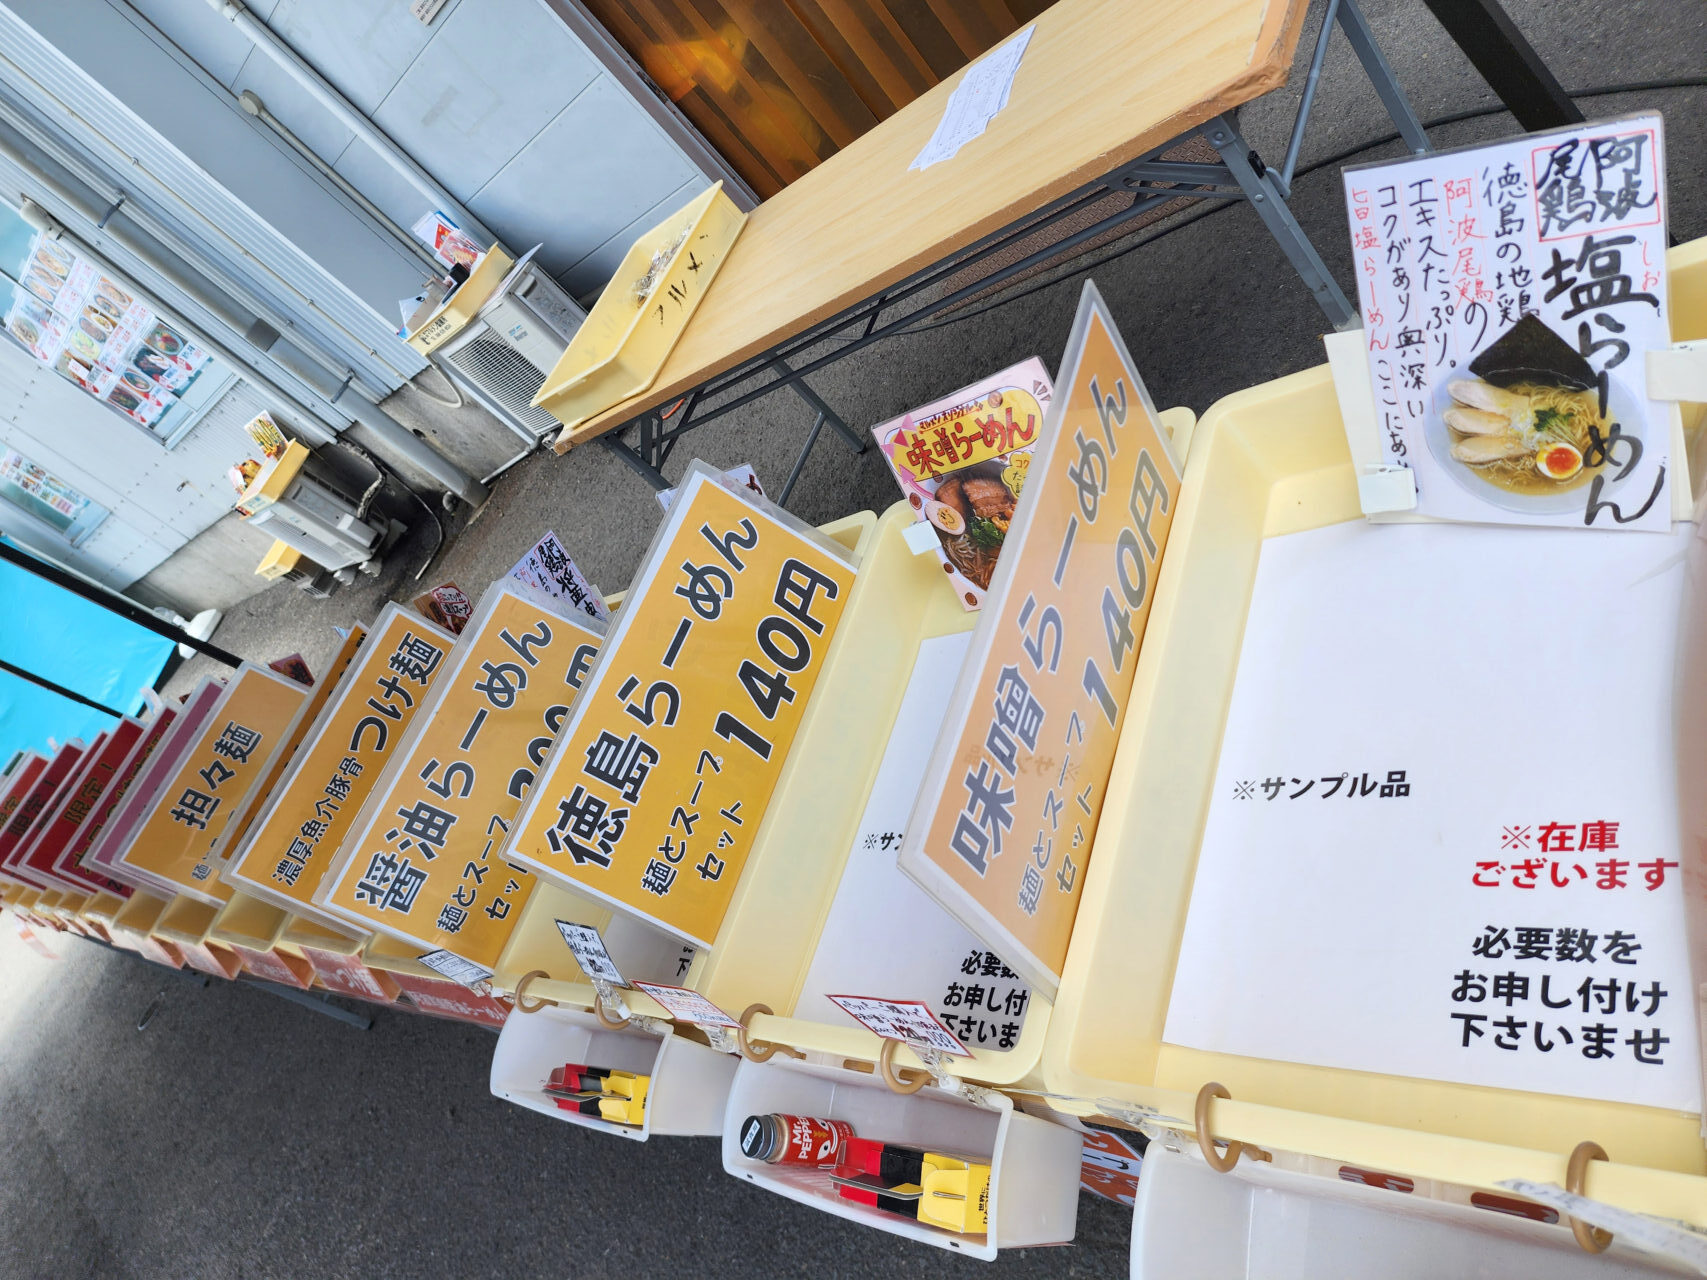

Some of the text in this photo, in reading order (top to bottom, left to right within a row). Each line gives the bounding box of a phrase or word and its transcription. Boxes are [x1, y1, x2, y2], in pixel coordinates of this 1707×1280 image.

[1541, 235, 1666, 526] 塩らーめん
[907, 408, 1034, 475] 味噌らーめん
[949, 374, 1128, 878] 味噌らーめん
[1082, 447, 1169, 729] 140円
[545, 516, 759, 870] 徳島らーめん
[714, 558, 839, 761] 140円
[170, 720, 263, 830] 担々麺
[354, 619, 554, 915] 醤油らーめん
[1017, 710, 1088, 917] 麺とスープ
[1233, 770, 1411, 802] ※サンプル品
[436, 814, 511, 936] 麺とスープ
[640, 749, 723, 898] 麺とスープ
[695, 800, 743, 882] セット
[1055, 783, 1093, 894] セット
[1472, 858, 1679, 891] ございます
[1501, 820, 1620, 853] ※在庫
[1450, 970, 1668, 1017] お申し付け
[1472, 925, 1642, 965] 必要数を
[1450, 1012, 1670, 1066] 下さいませ
[791, 1119, 804, 1145] Mr.
[798, 1116, 813, 1159] PEPPE
